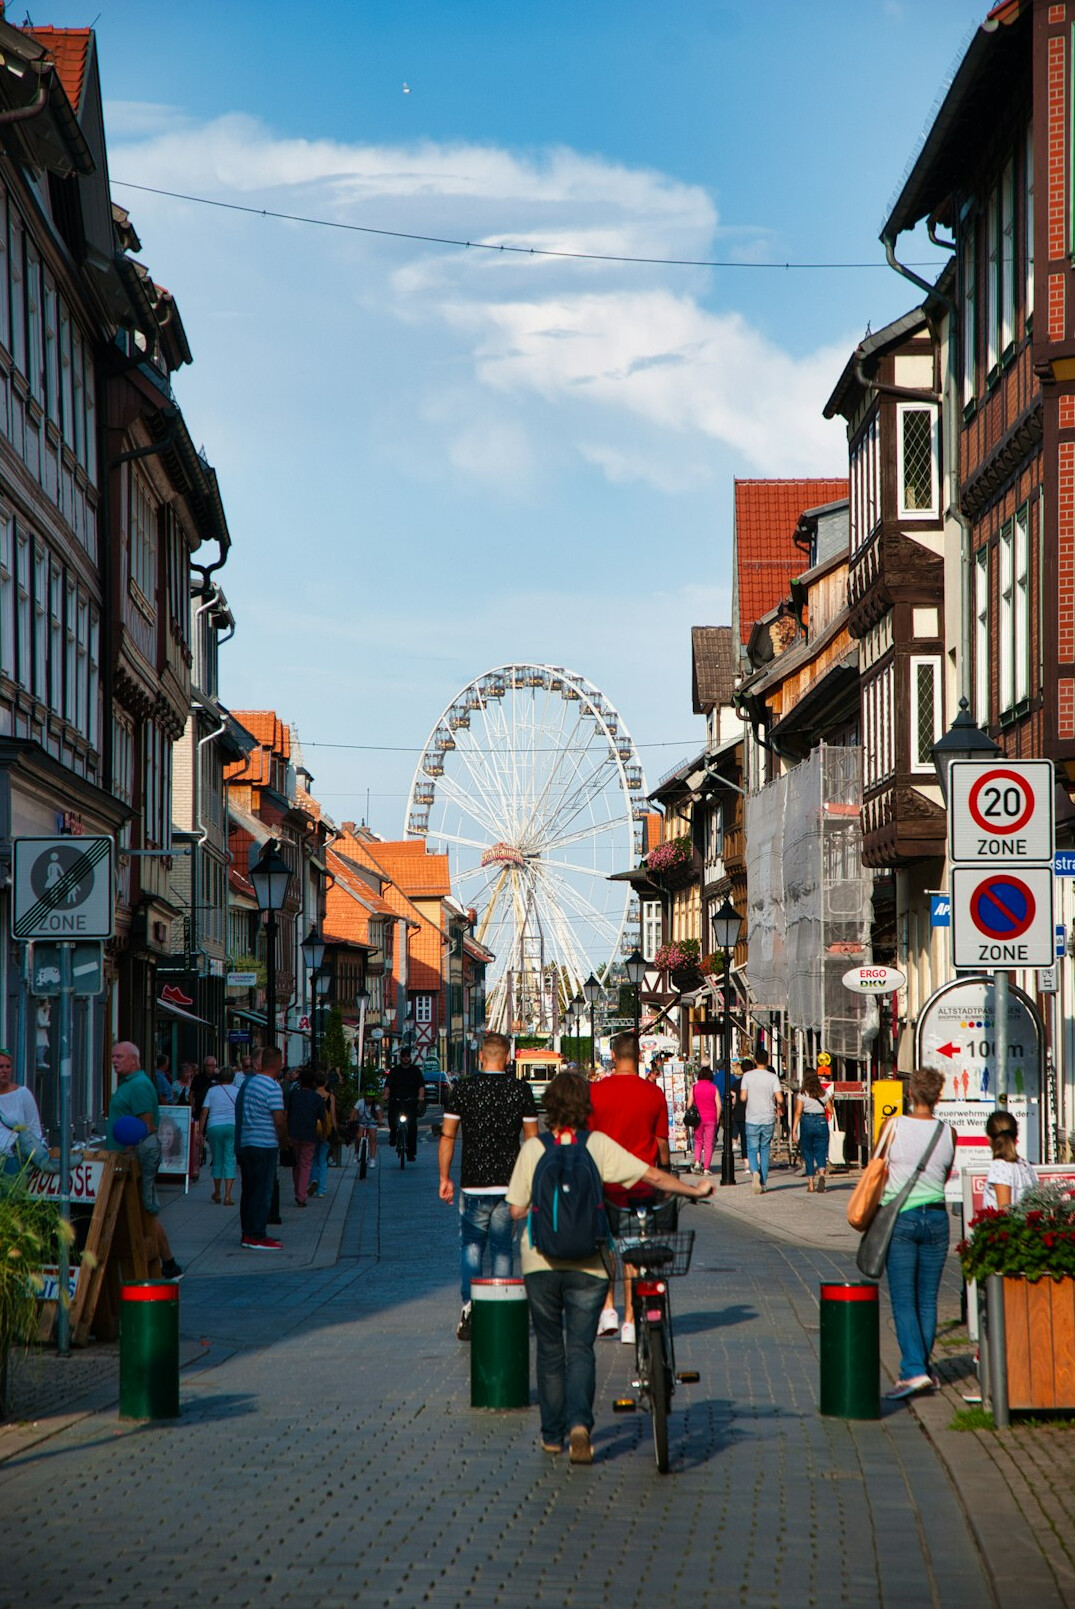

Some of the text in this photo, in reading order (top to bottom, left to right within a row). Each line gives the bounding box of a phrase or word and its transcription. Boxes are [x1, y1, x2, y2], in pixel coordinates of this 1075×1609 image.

[984, 788, 1020, 816] 20
[977, 840, 1027, 855] ZONE
[38, 915, 87, 931] ZONE
[978, 945, 1028, 960] ZONE
[860, 969, 887, 978] ERGO
